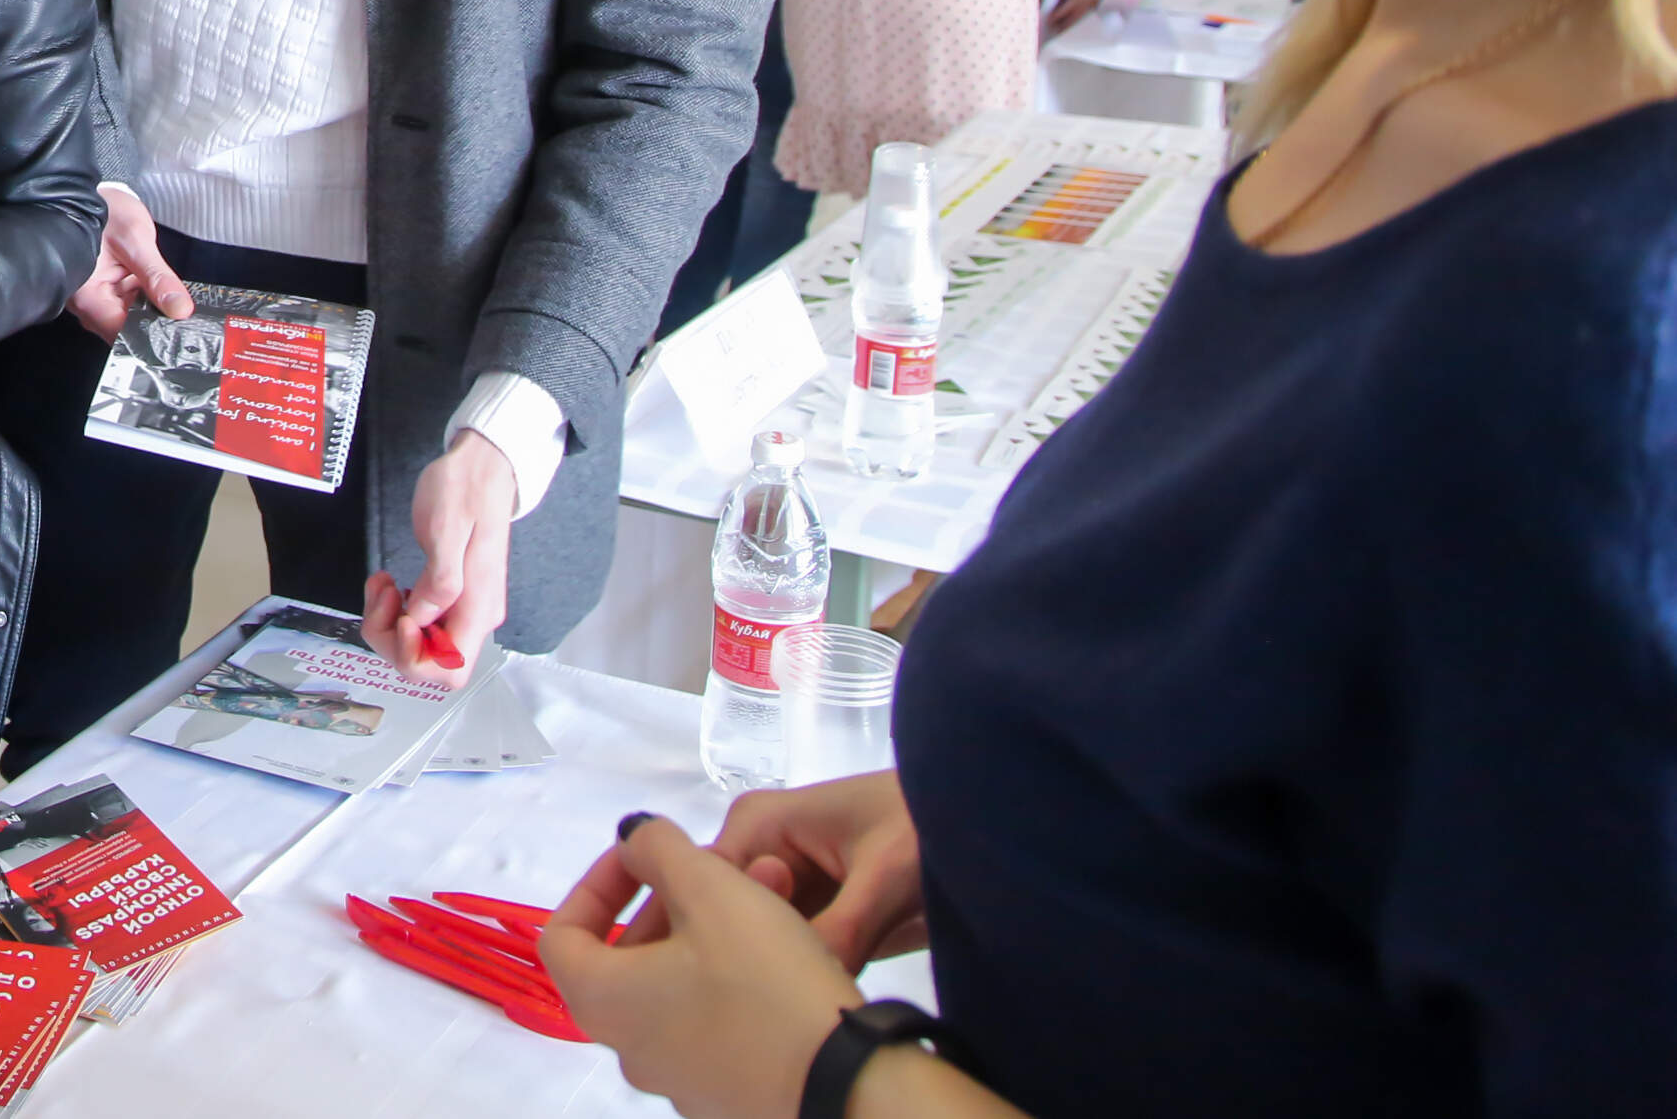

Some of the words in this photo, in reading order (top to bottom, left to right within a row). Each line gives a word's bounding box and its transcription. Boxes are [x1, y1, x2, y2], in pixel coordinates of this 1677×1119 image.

[283, 393, 316, 405] not
[212, 407, 241, 421] for
[270, 434, 304, 447] am
[289, 649, 318, 662] ТЫ
[321, 657, 356, 673] ЧТО
[306, 665, 446, 702] НЕВОЗМОЖНО
[68, 853, 165, 909] КАРЬЕРЫ
[107, 864, 177, 907] СВОЕЙ
[75, 873, 193, 940] INKOMPASS
[122, 884, 204, 936] ОТКРОЙ
